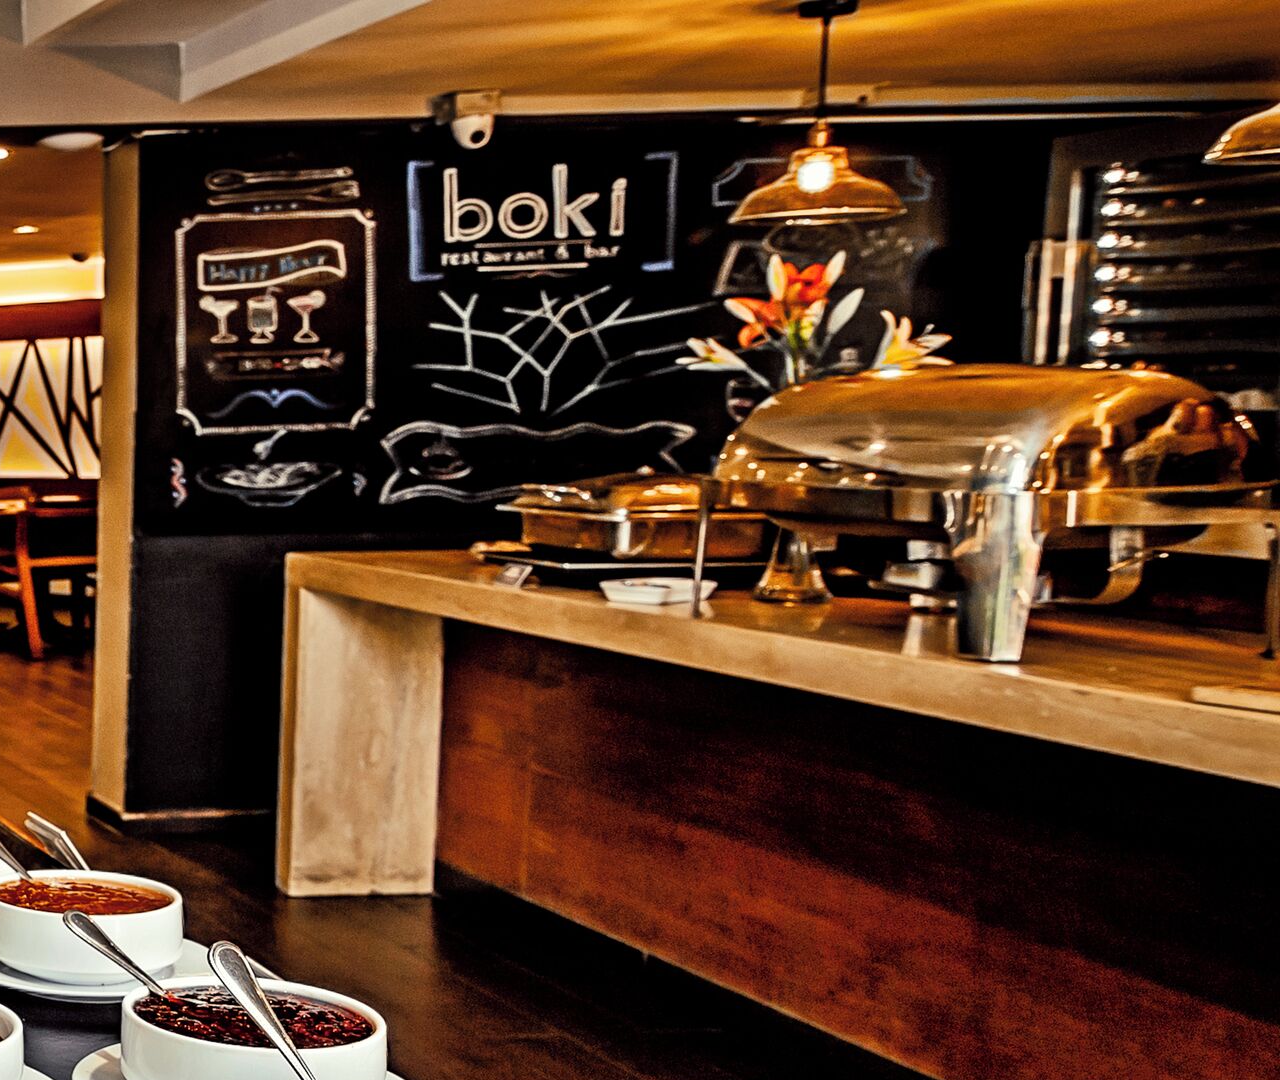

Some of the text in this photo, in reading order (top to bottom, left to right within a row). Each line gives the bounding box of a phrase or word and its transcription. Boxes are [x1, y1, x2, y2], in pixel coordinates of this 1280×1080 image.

[443, 163, 627, 243] boki
[440, 248, 545, 267] restaurant
[583, 242, 621, 259] bar
